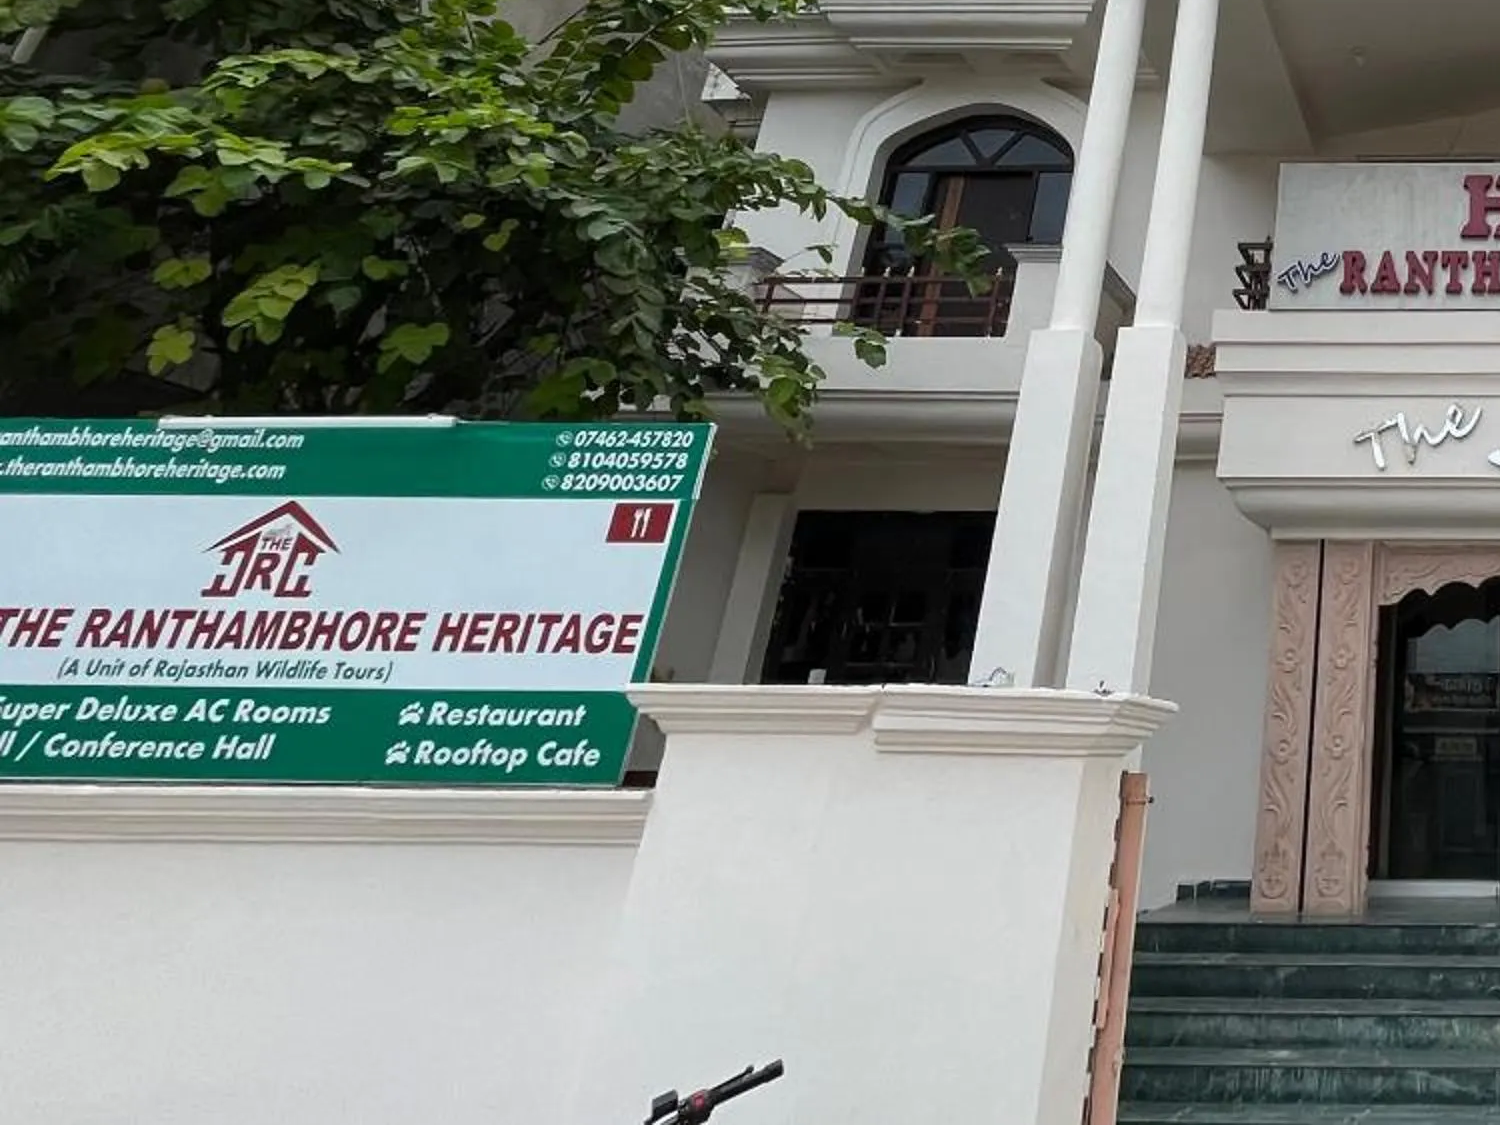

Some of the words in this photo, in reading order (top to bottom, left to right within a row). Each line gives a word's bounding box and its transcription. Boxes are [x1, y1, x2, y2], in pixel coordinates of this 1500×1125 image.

[1277, 250, 1341, 293] The
[574, 430, 694, 448] 07462-457820
[1354, 401, 1483, 472] The
[567, 452, 688, 470] 8104059578
[560, 474, 684, 492] 8209003607
[261, 537, 293, 551] THE
[0, 608, 74, 649] THE
[75, 609, 427, 653] RANTHAMBHORE
[432, 613, 645, 655] HERITAGE
[86, 659, 125, 677] Unit
[129, 658, 151, 678] of
[155, 660, 249, 682] Rajasthan
[255, 661, 328, 680] Wildlife
[334, 661, 393, 684] Tours)
[75, 696, 177, 722] Deluxe
[184, 698, 230, 723] AC
[233, 699, 332, 725] Rooms
[427, 701, 587, 727] Restaurant
[44, 731, 205, 760] Conference
[212, 733, 277, 761] Hall
[413, 739, 528, 775] Rooftop
[536, 739, 601, 768] Cafe
